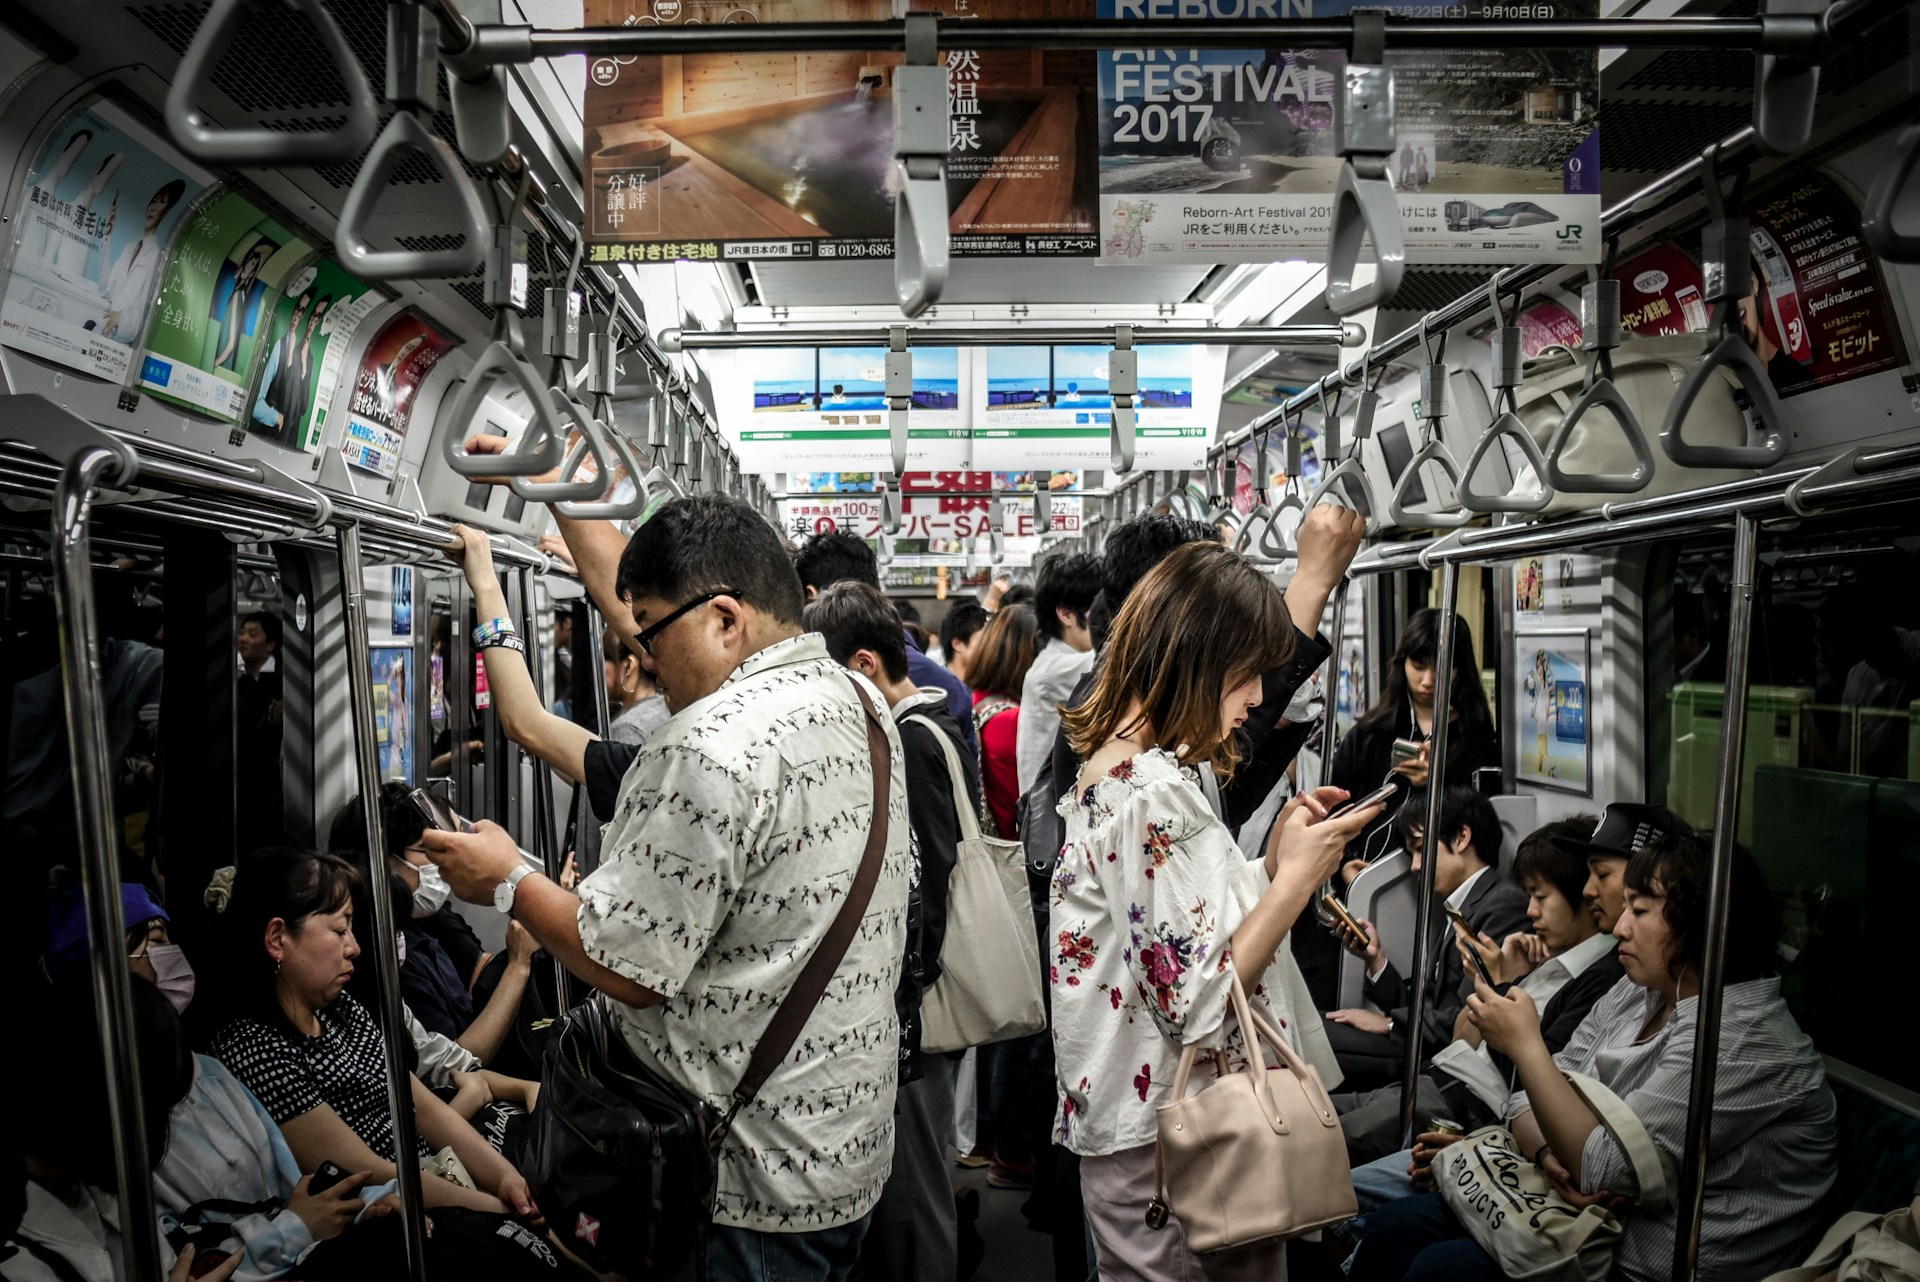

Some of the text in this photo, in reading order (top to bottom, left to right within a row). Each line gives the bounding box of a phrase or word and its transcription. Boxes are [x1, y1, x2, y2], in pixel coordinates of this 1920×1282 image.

[1115, 64, 1333, 102] FESTIVAL
[1113, 104, 1213, 142] 2017
[606, 174, 626, 229] 分譲中
[628, 174, 647, 210] 好評
[1183, 207, 1335, 218] Reborn-Art Festival 201
[1183, 223, 1300, 235] JRをご利用ください。
[1556, 224, 1582, 239] JR
[589, 243, 718, 262] 温泉付き住宅地
[727, 245, 788, 255] JR東日本の街
[1808, 293, 1829, 317] Speed
[1828, 329, 1880, 363] モビット
[790, 517, 813, 539] 楽
[1451, 1153, 1505, 1230] PRODUCTS
